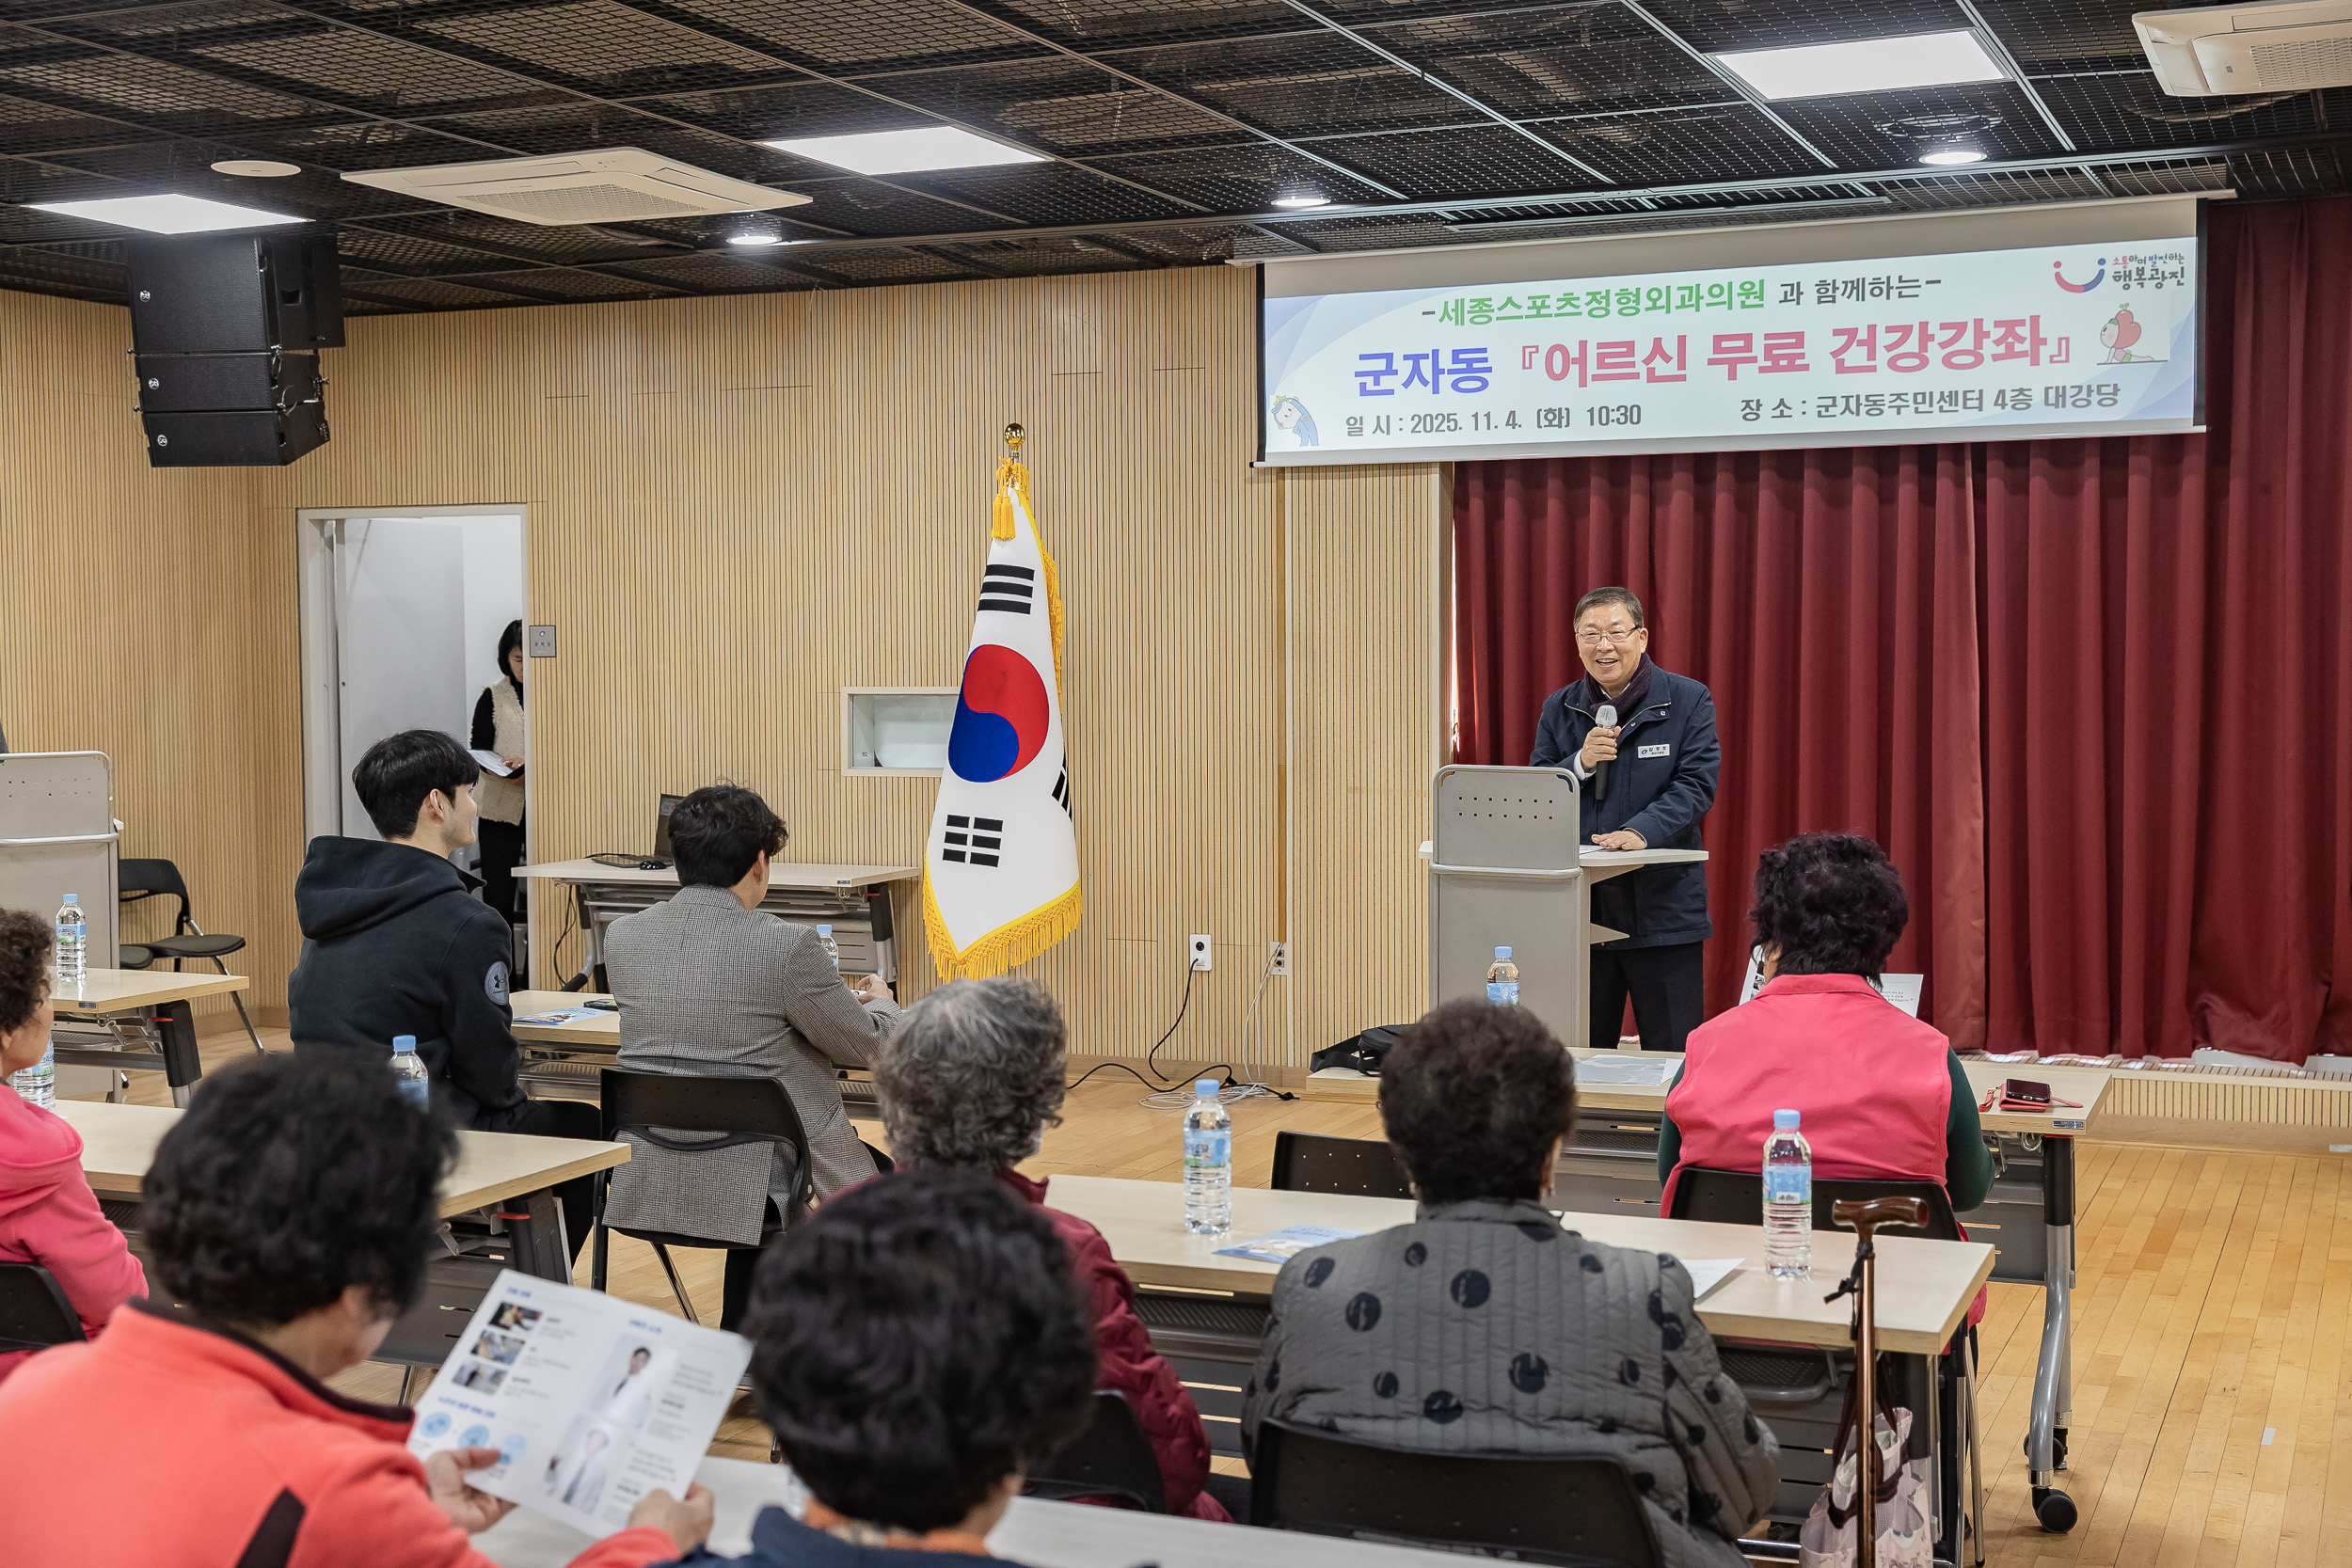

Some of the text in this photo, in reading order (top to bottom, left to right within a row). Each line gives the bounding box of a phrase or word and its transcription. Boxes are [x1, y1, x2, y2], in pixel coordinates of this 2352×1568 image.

[2149, 253, 2185, 267] 발전하는
[2112, 265, 2184, 290] 행복광진
[1779, 281, 1804, 305] 과
[1355, 348, 1492, 396] 군자동
[1708, 331, 1809, 381] 무료
[1830, 315, 2070, 374] 건강강좌』
[1817, 389, 1983, 418] 군자동주민센터
[1994, 388, 2032, 410] 4층
[2044, 384, 2121, 408] 대강당
[1411, 413, 1462, 433] 2025.
[1471, 411, 1498, 431] 11.
[1505, 411, 1521, 429] 4.
[1587, 404, 1641, 426] 10:30
